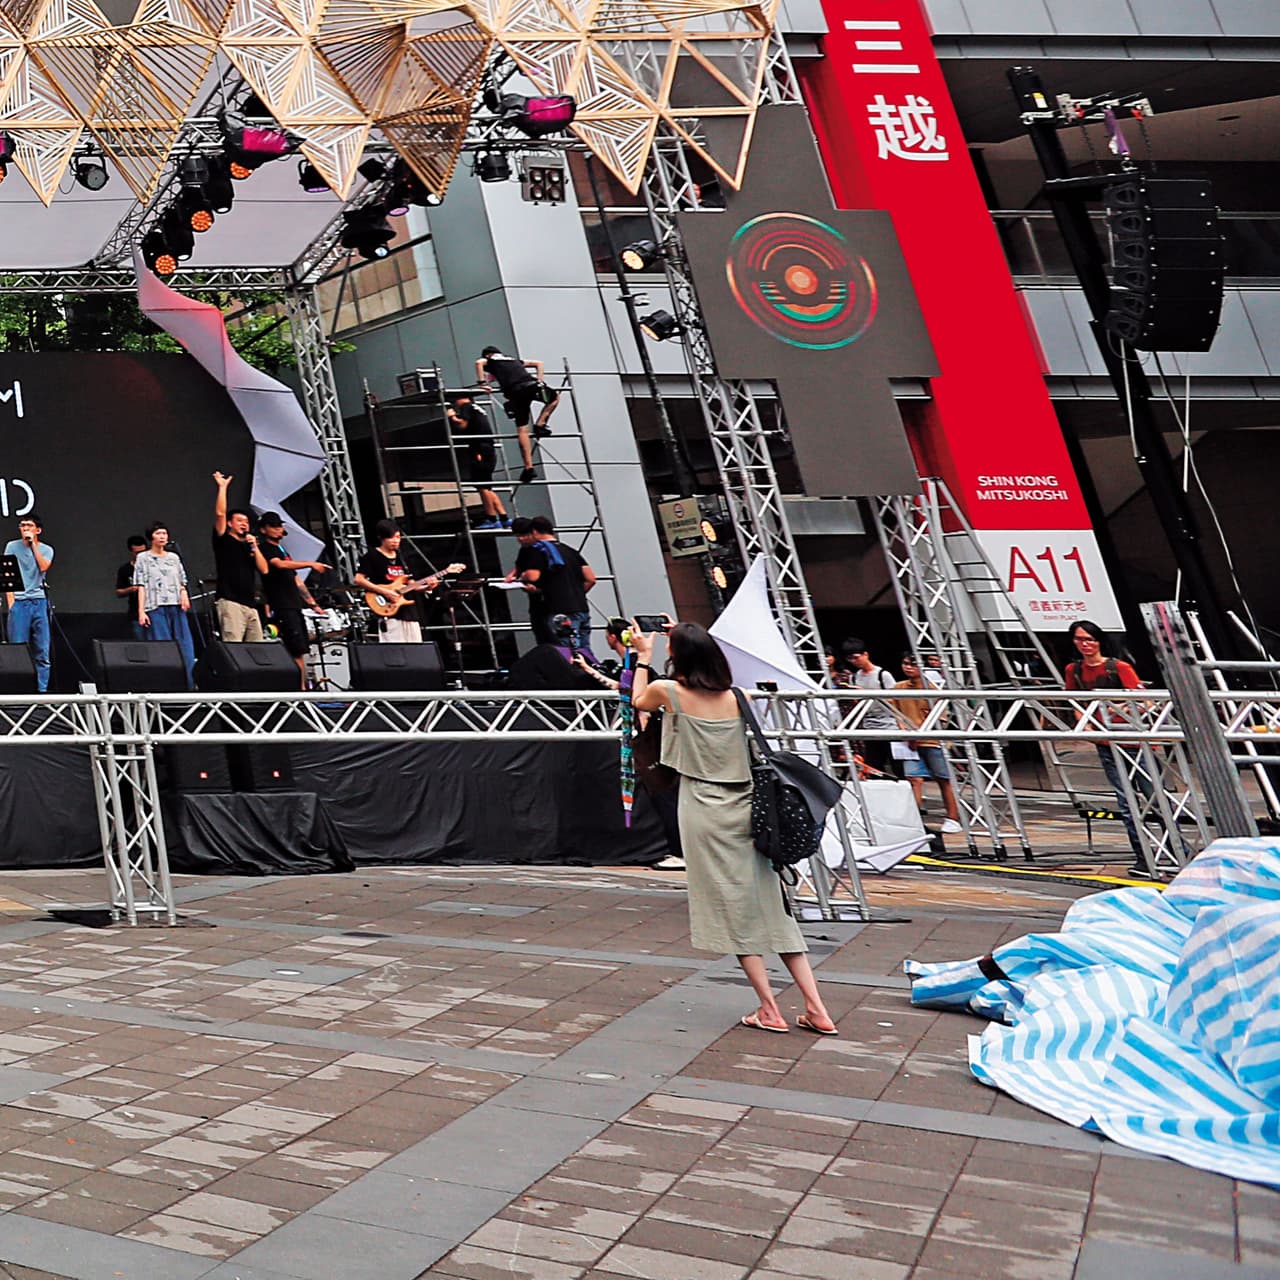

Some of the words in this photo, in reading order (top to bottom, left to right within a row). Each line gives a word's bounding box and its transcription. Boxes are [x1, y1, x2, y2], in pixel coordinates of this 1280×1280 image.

[977, 475, 1015, 487] SHIN
[1014, 475, 1059, 487] KONG
[976, 489, 1069, 501] MITSUKOSHI
[1007, 546, 1092, 593] A11
